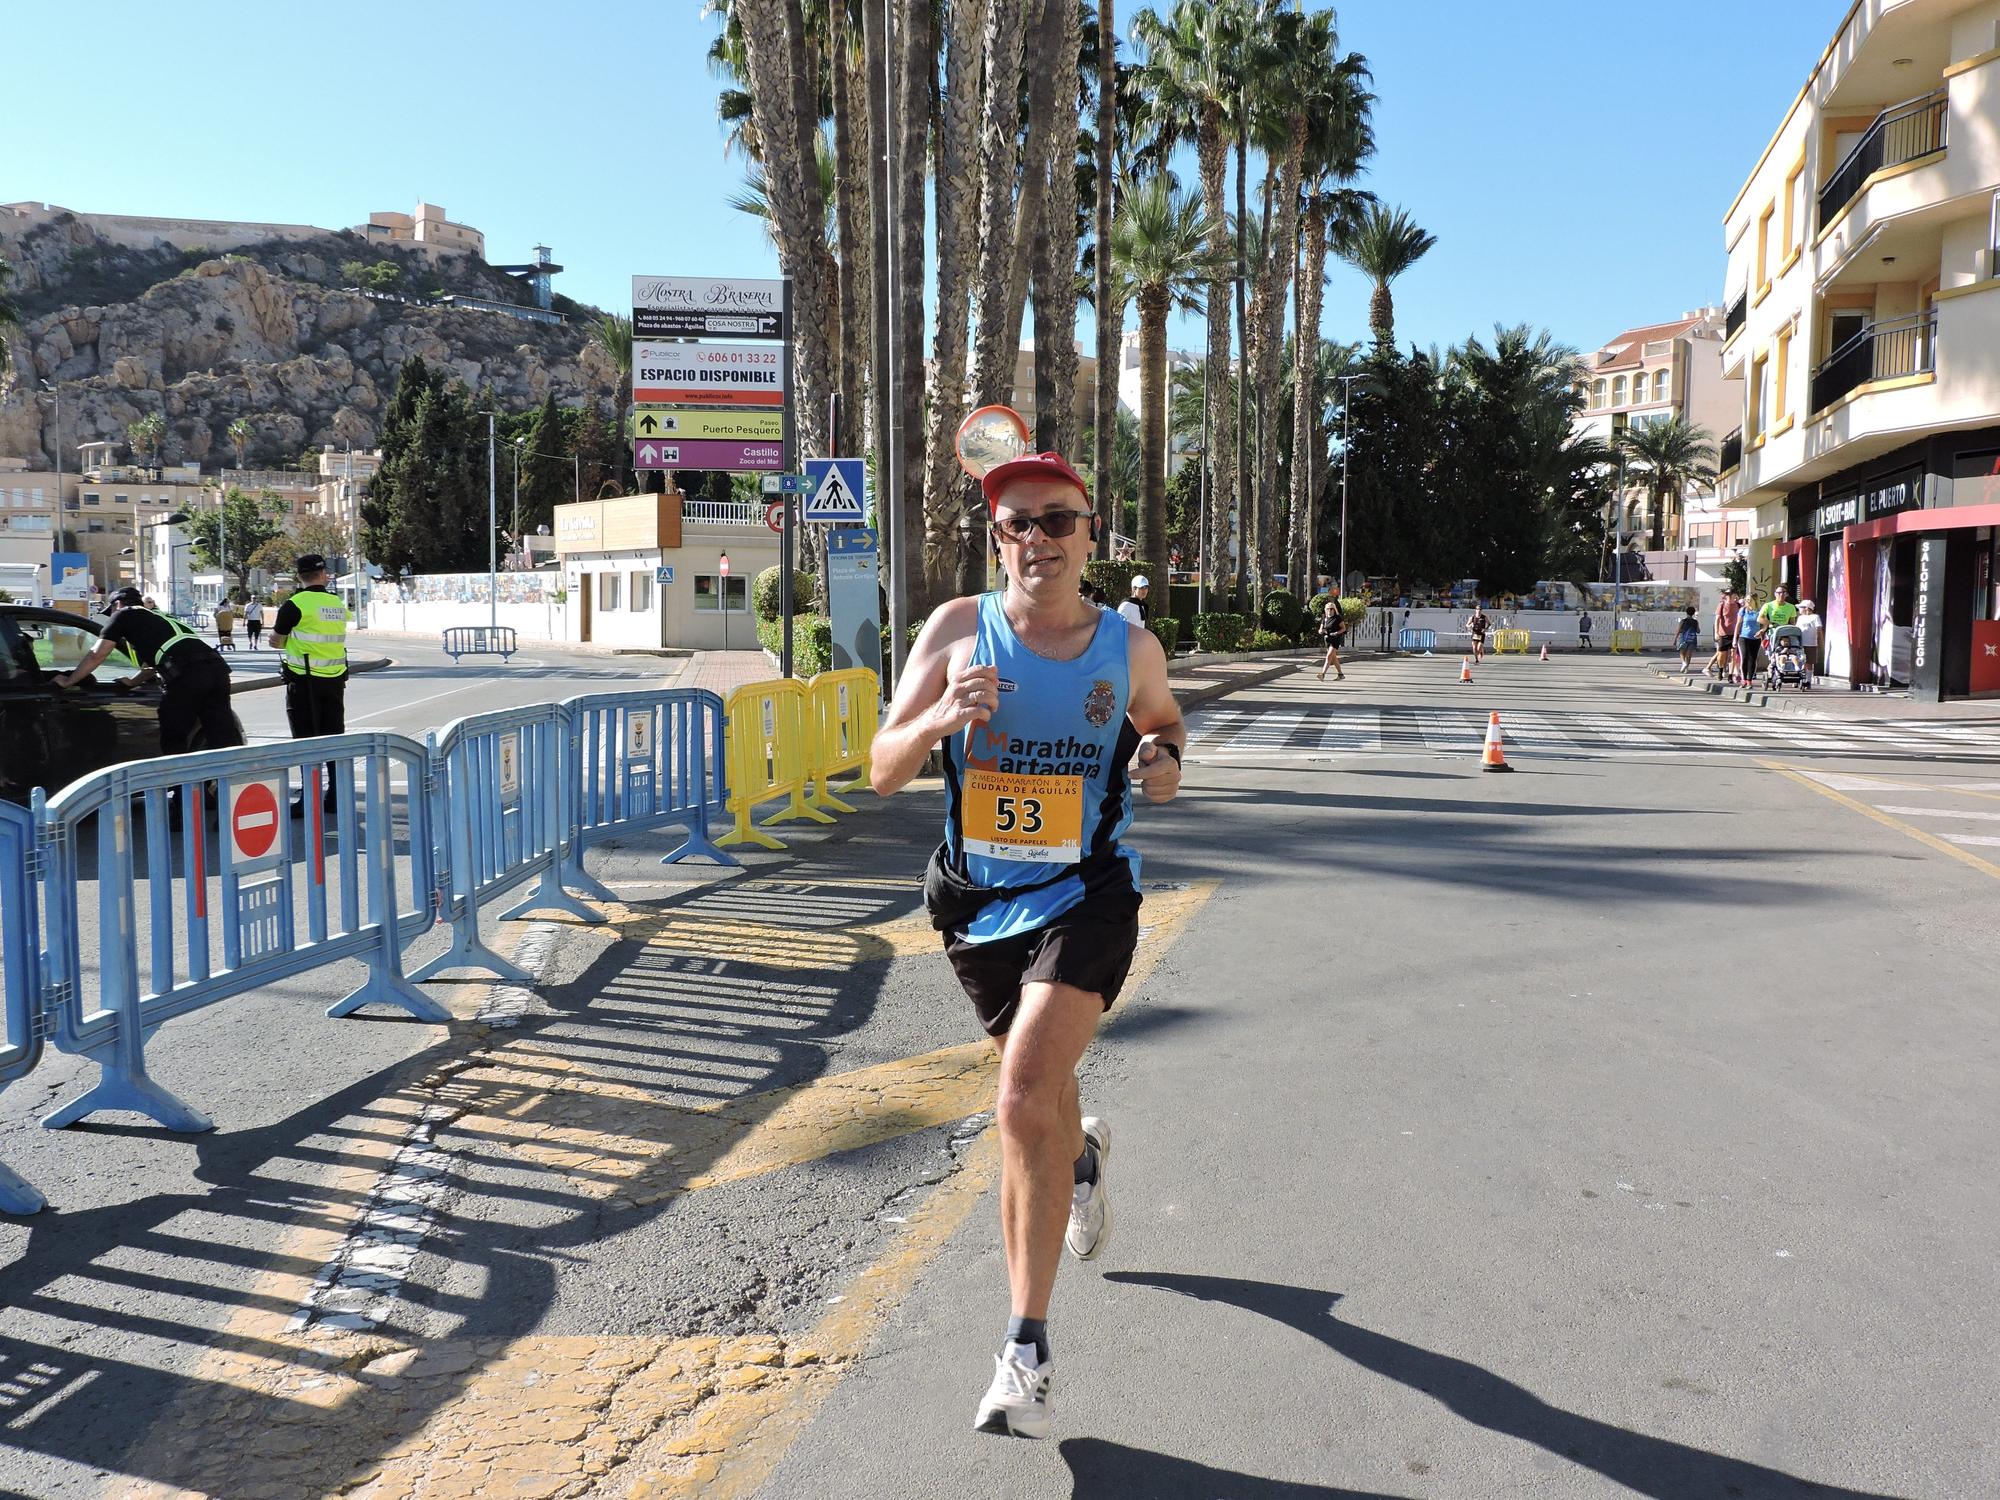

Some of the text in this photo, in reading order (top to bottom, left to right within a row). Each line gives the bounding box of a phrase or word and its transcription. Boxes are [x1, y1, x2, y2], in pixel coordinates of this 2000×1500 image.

[707, 352, 776, 364] 606 01 33 22
[640, 368, 776, 383] ESPACIO DISPONIBLE
[703, 425, 781, 436] Puerto Pesquero
[743, 447, 779, 457] Castillo
[1870, 492, 1878, 513] EL
[1878, 483, 1905, 510] PUERTO
[1915, 541, 1930, 667] SALON DE JUEGO
[979, 774, 1004, 783] MEDIA
[1055, 779, 1061, 787] &
[1066, 779, 1078, 787] 7K
[971, 782, 1008, 792] CIUDAD
[995, 796, 1044, 834] 53
[990, 836, 1008, 844] LISTO
[1019, 838, 1048, 846] PAPELES
